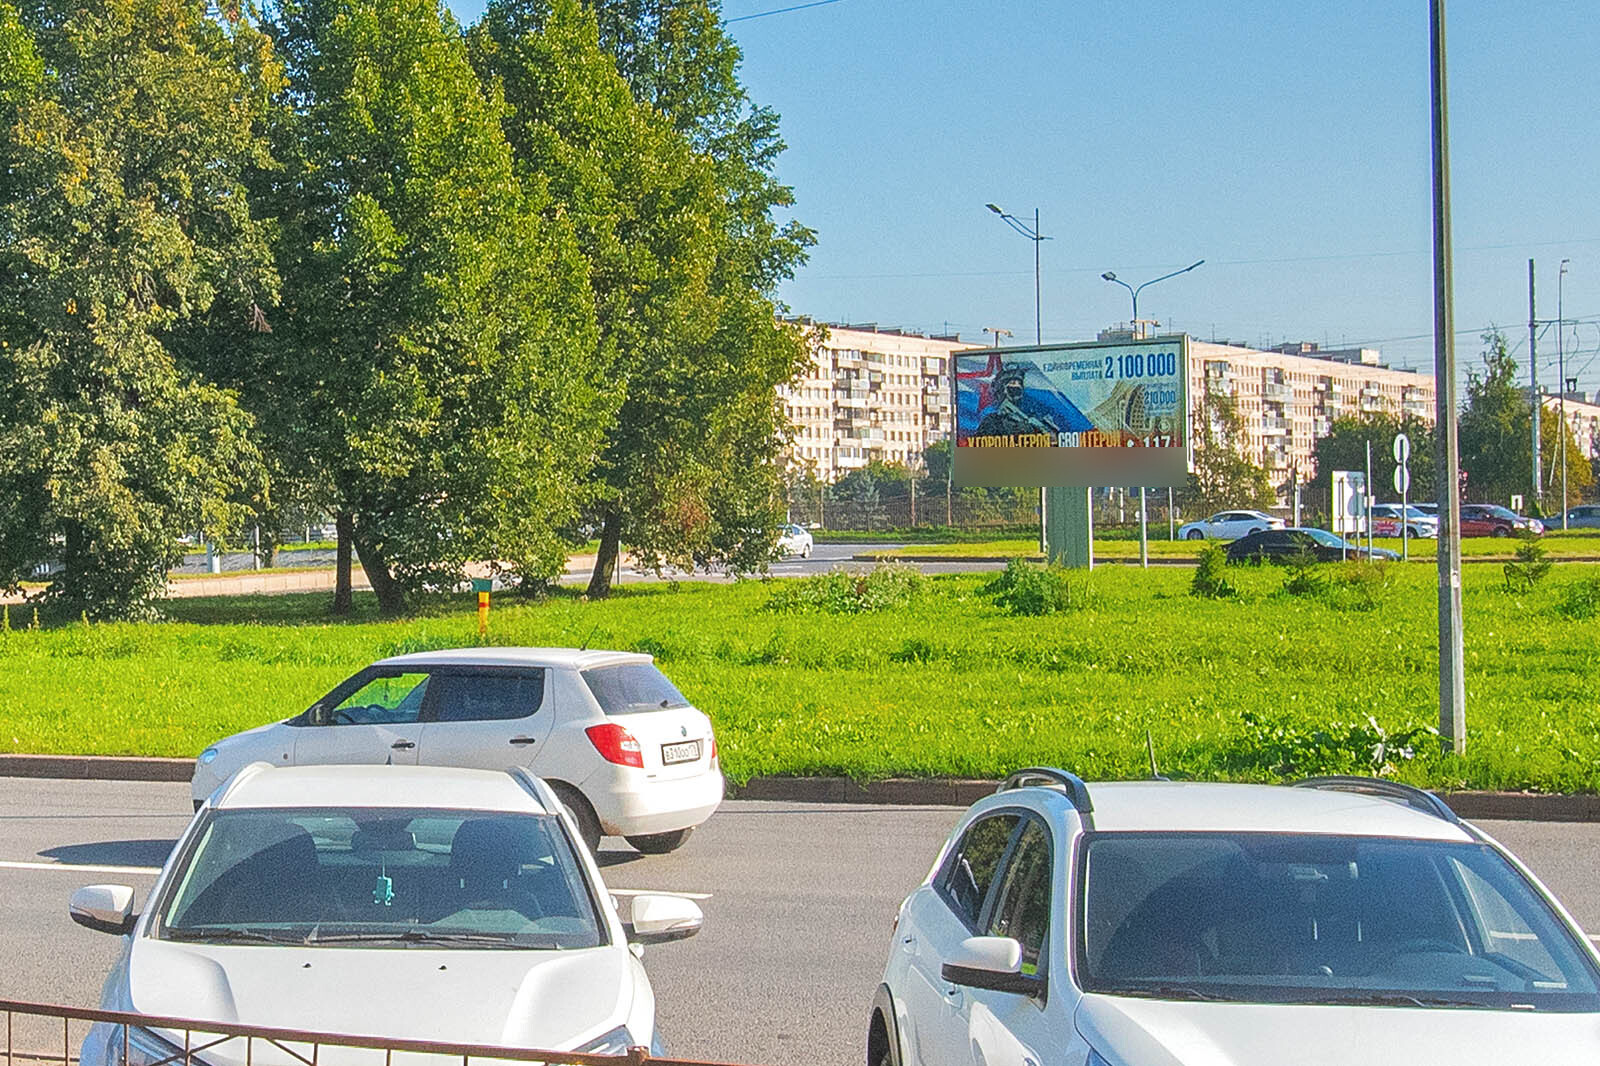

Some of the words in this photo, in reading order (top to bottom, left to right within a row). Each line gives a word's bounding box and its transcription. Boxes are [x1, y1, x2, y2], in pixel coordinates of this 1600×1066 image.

[1105, 356, 1114, 378] 2
[1117, 354, 1144, 378] 100
[1147, 352, 1176, 377] 000
